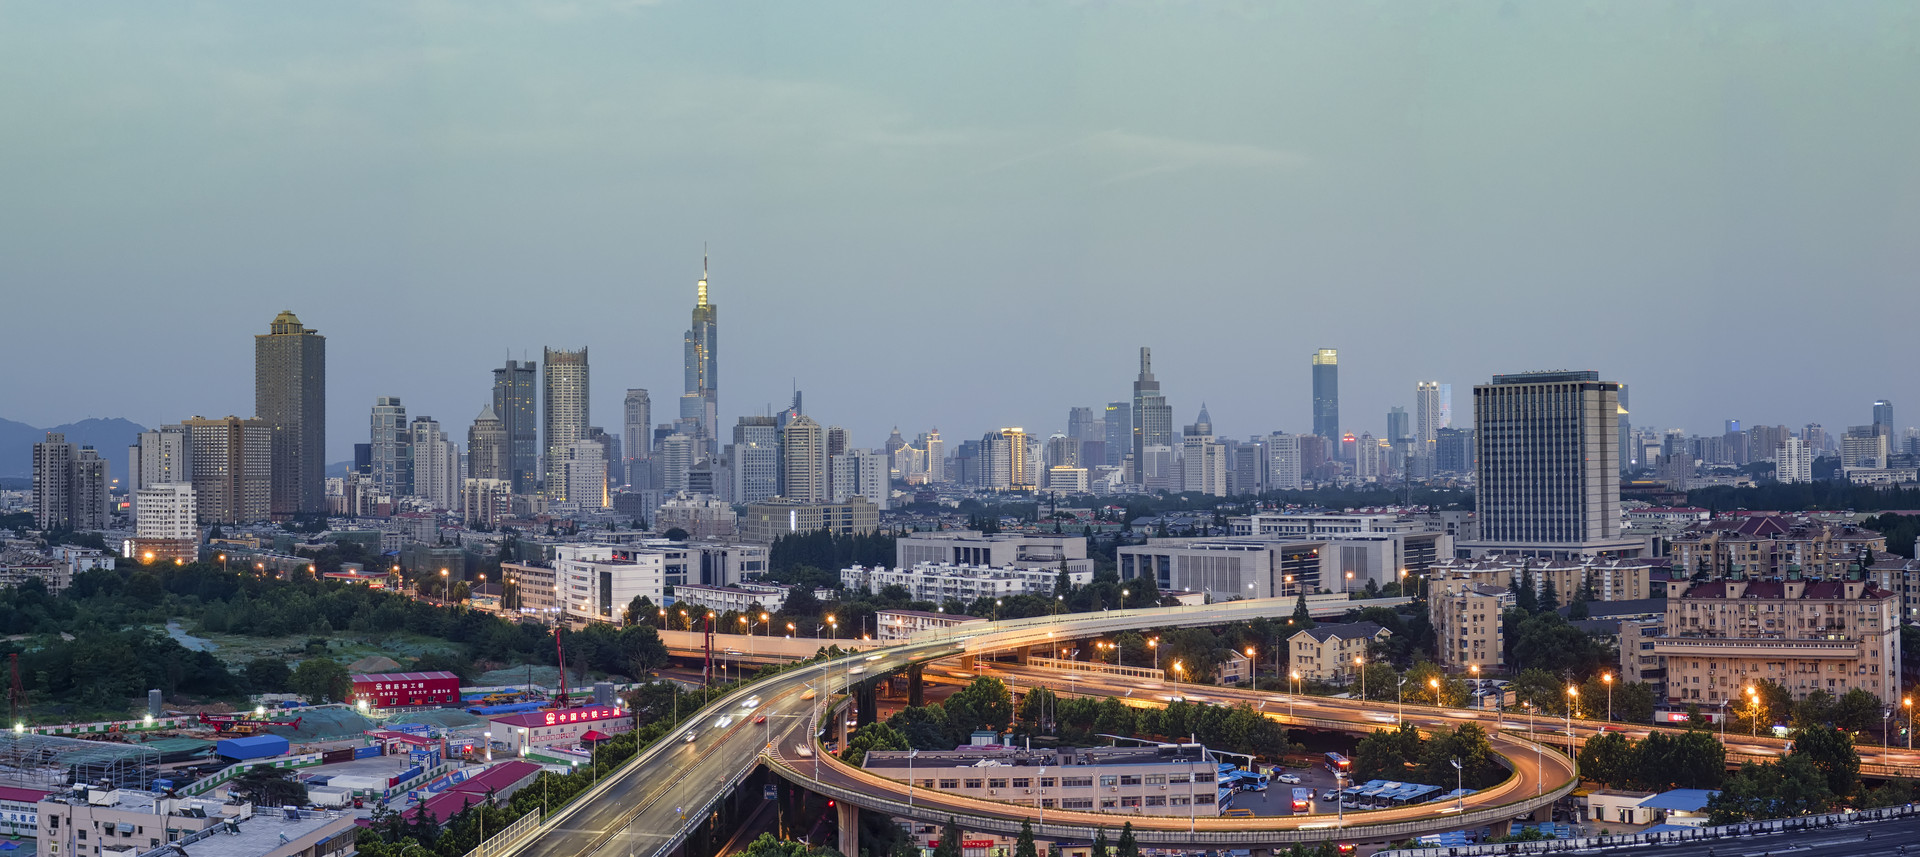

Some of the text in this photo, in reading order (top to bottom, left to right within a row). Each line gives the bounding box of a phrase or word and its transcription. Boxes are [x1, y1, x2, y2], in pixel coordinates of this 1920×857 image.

[559, 707, 620, 722] 中国中铁二局
